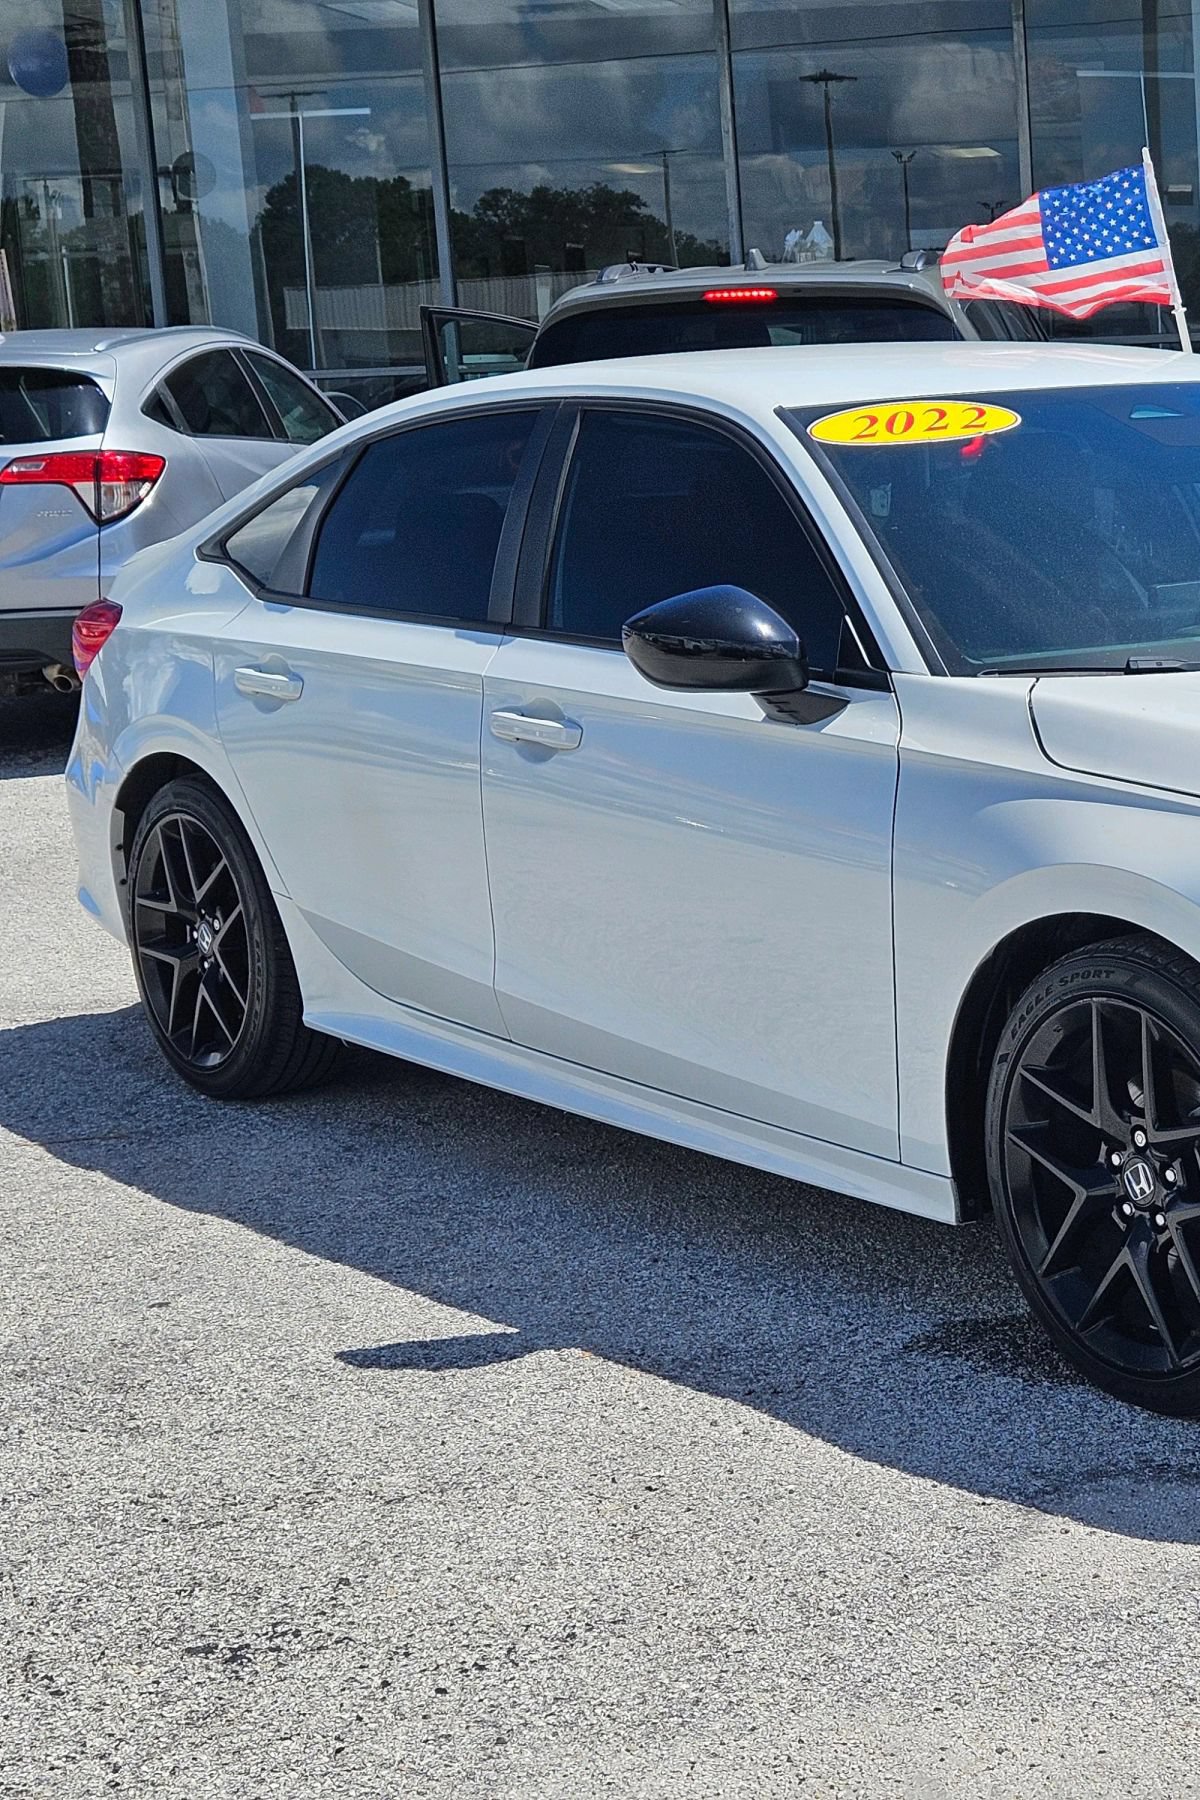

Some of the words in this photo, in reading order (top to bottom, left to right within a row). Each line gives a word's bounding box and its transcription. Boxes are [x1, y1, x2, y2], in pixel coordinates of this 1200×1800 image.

[851, 407, 988, 440] 2022
[1011, 984, 1054, 1040] EAGLE
[1059, 969, 1115, 987] SPORT
